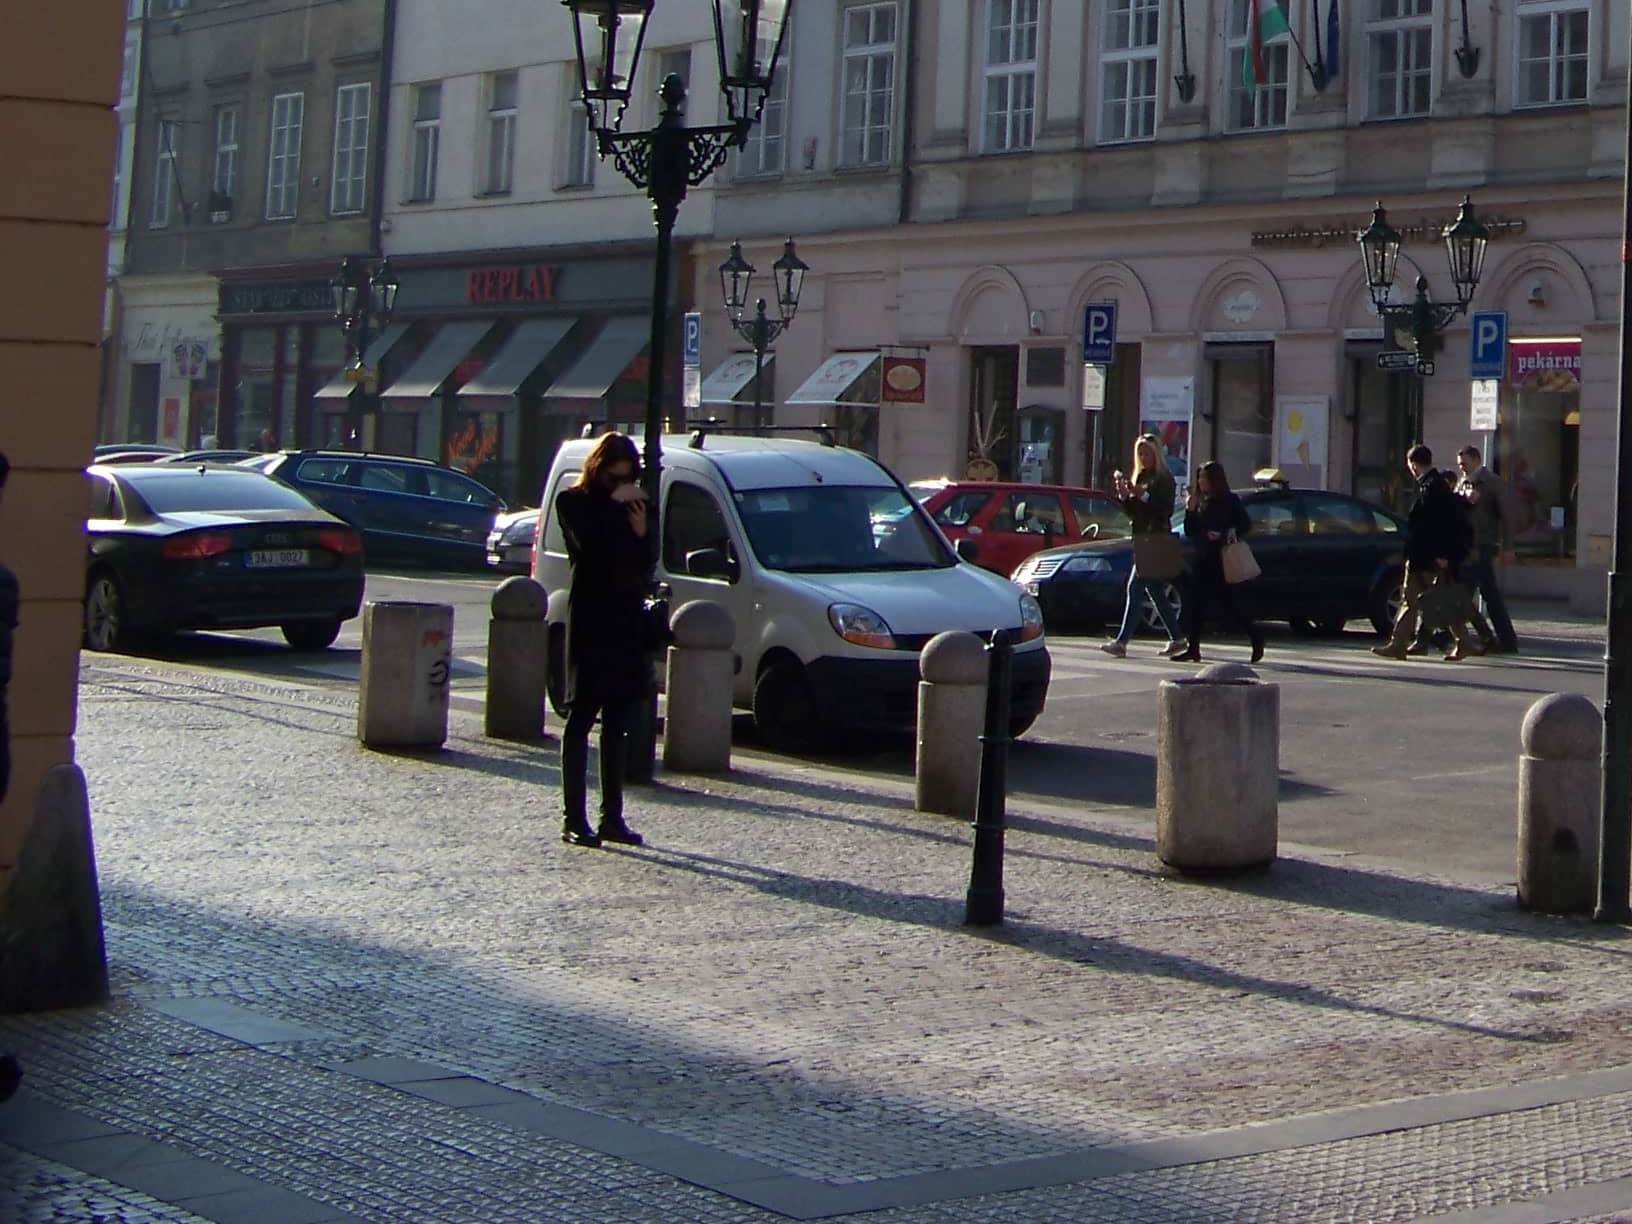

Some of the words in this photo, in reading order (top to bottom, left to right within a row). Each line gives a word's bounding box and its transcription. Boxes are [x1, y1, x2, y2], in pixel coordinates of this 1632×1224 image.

[465, 264, 561, 305] REPLAY
[1090, 310, 1108, 345] P
[1477, 319, 1498, 359] P
[1517, 351, 1582, 373] pekárna
